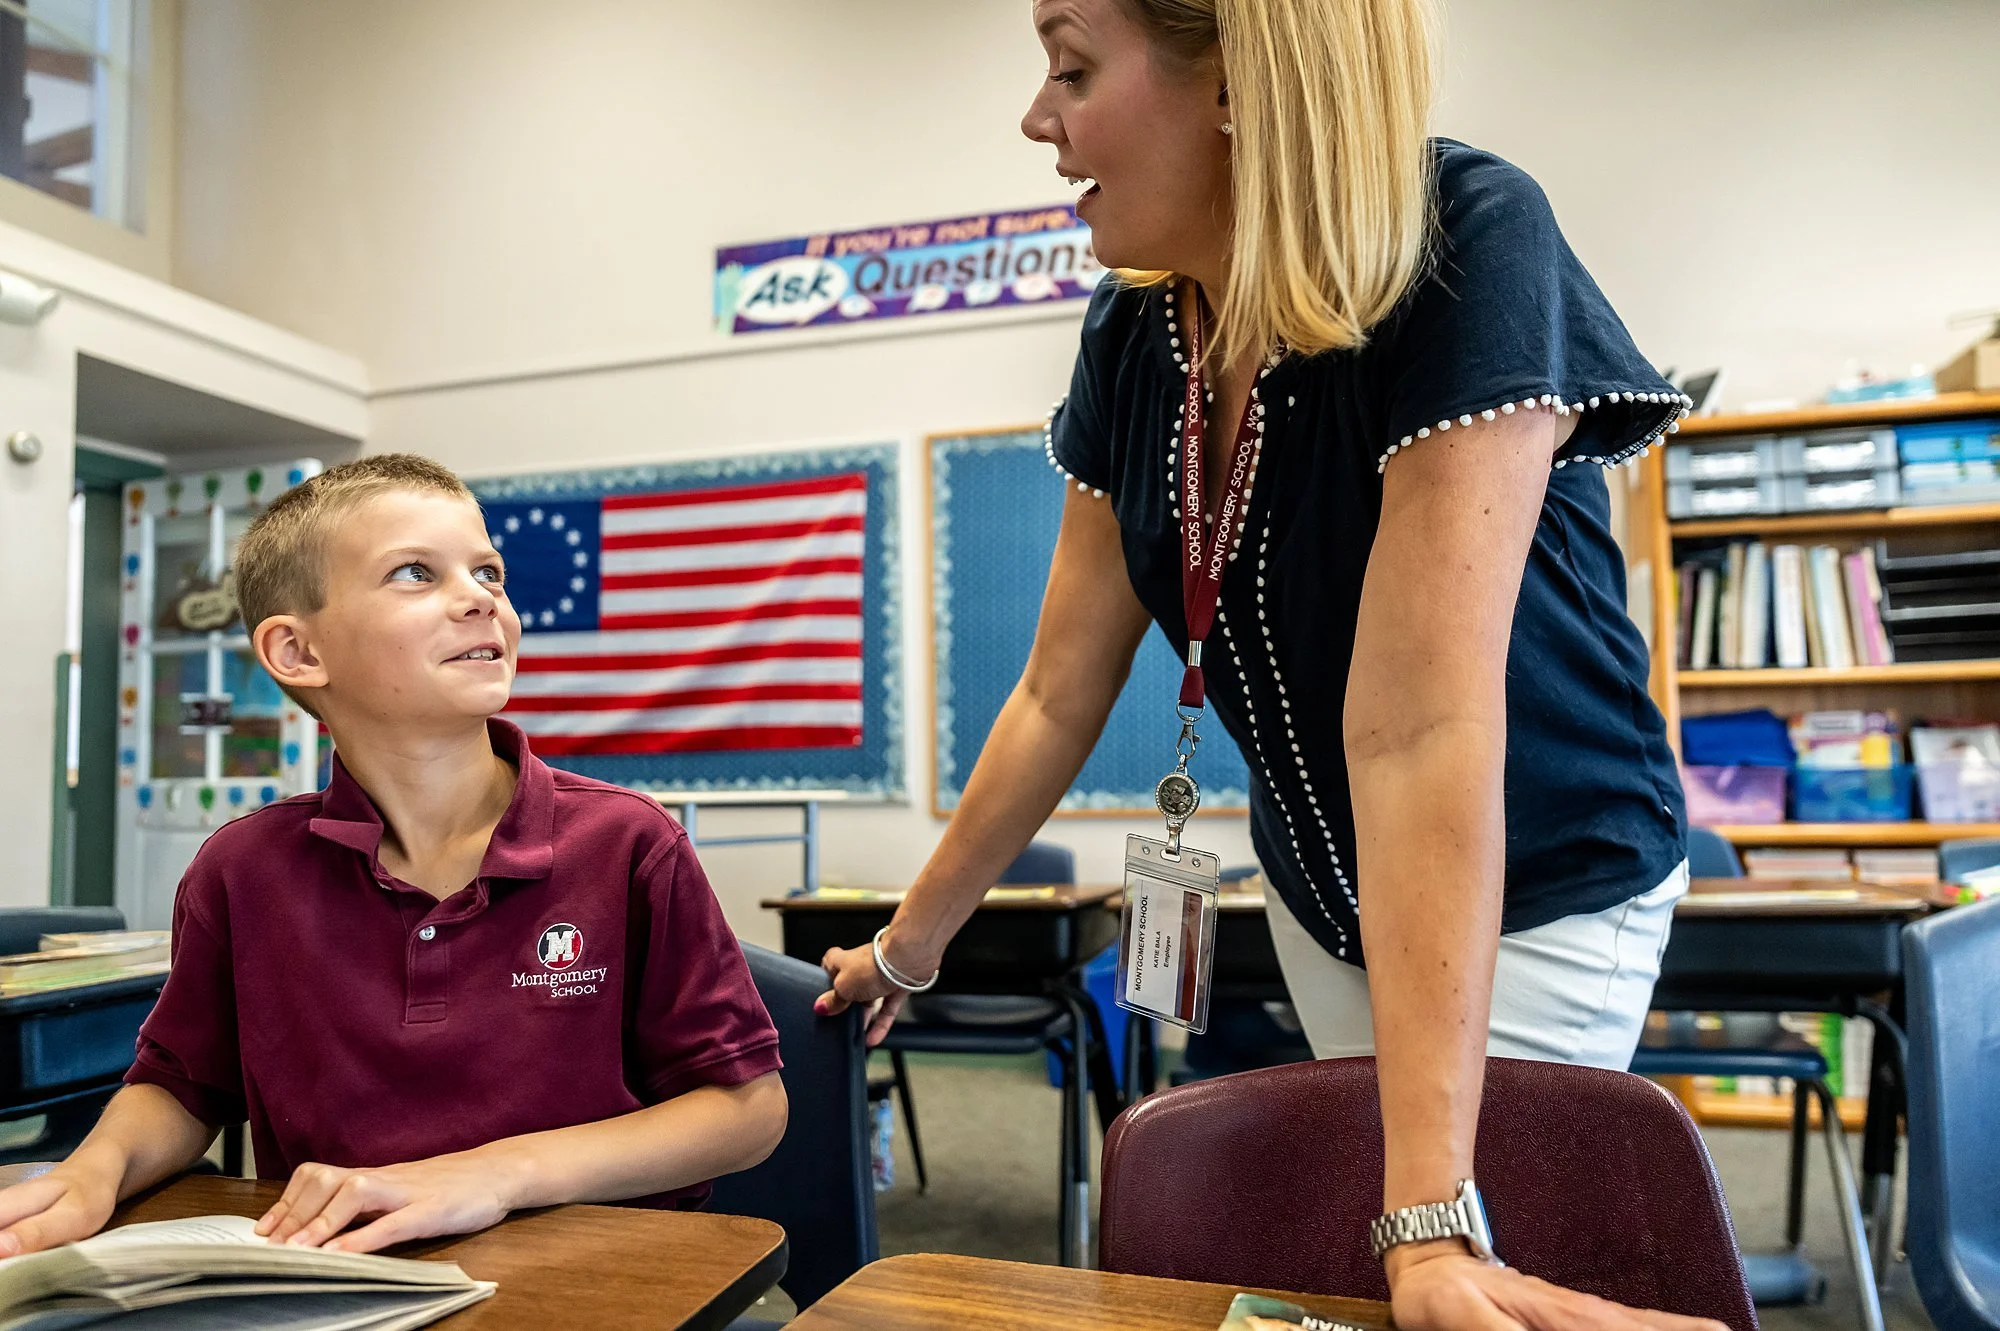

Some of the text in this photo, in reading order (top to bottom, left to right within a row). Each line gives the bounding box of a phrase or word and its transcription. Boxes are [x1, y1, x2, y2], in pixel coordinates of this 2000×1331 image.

[833, 225, 931, 257] you're
[933, 215, 990, 244] not
[744, 262, 834, 309] Ask
[1188, 381, 1199, 429] SCHOOL
[1187, 435, 1201, 572] MONTGOMERY SCHOOL
[1208, 438, 1254, 581] MONTGOMERY SCHOOL
[545, 930, 575, 962] M
[1135, 895, 1148, 991] MONTGOMERY SCHOOL
[1163, 935, 1172, 968] Employee
[511, 967, 608, 988] Montgomery
[550, 984, 598, 998] SCHOOL
